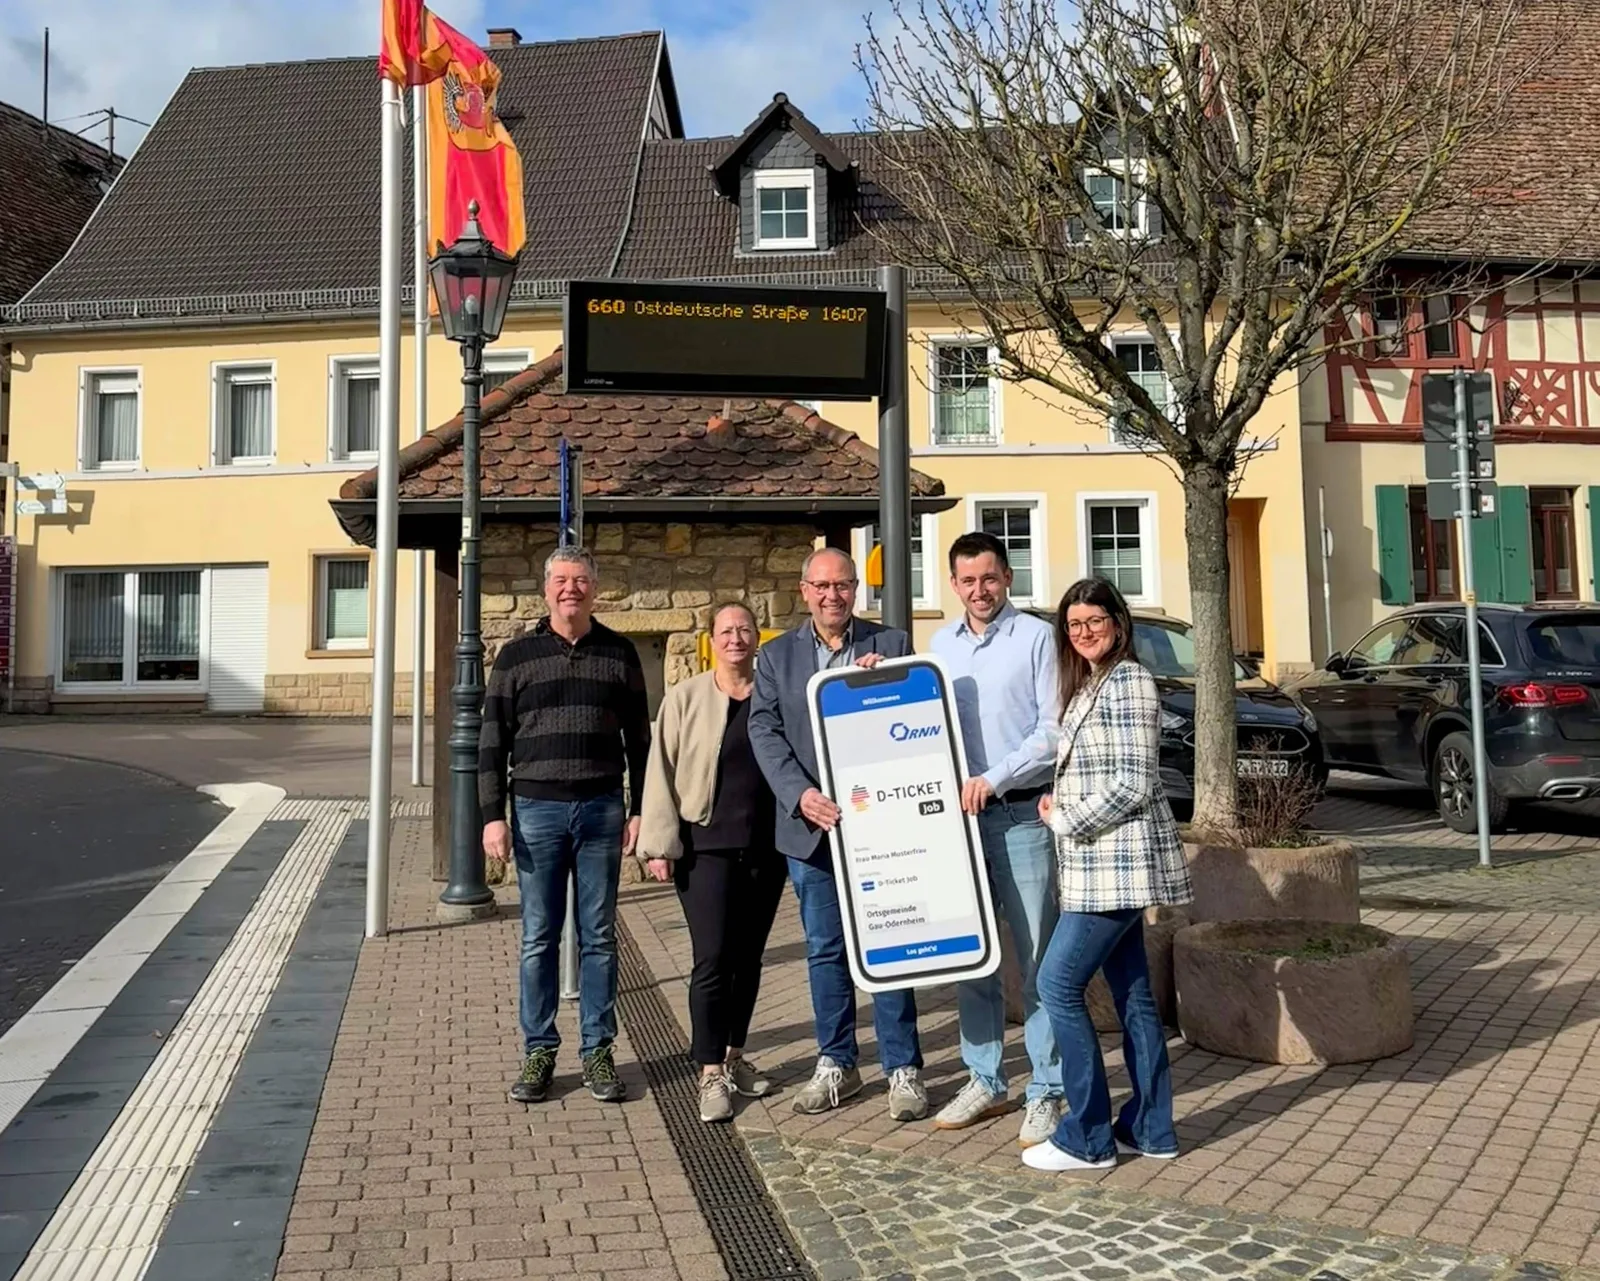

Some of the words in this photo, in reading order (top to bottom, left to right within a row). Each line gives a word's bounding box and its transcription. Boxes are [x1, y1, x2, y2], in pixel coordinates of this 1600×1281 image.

[587, 299, 626, 314] 660
[634, 300, 744, 318] Ostdeutsche
[752, 304, 809, 323] Straße
[822, 306, 867, 322] 16:07
[908, 725, 942, 740] RNN
[876, 781, 943, 802] D-TICKET
[923, 802, 941, 814] Job
[866, 905, 917, 918] Ortsgemeinde
[868, 917, 926, 930] Gau-Odernheim
